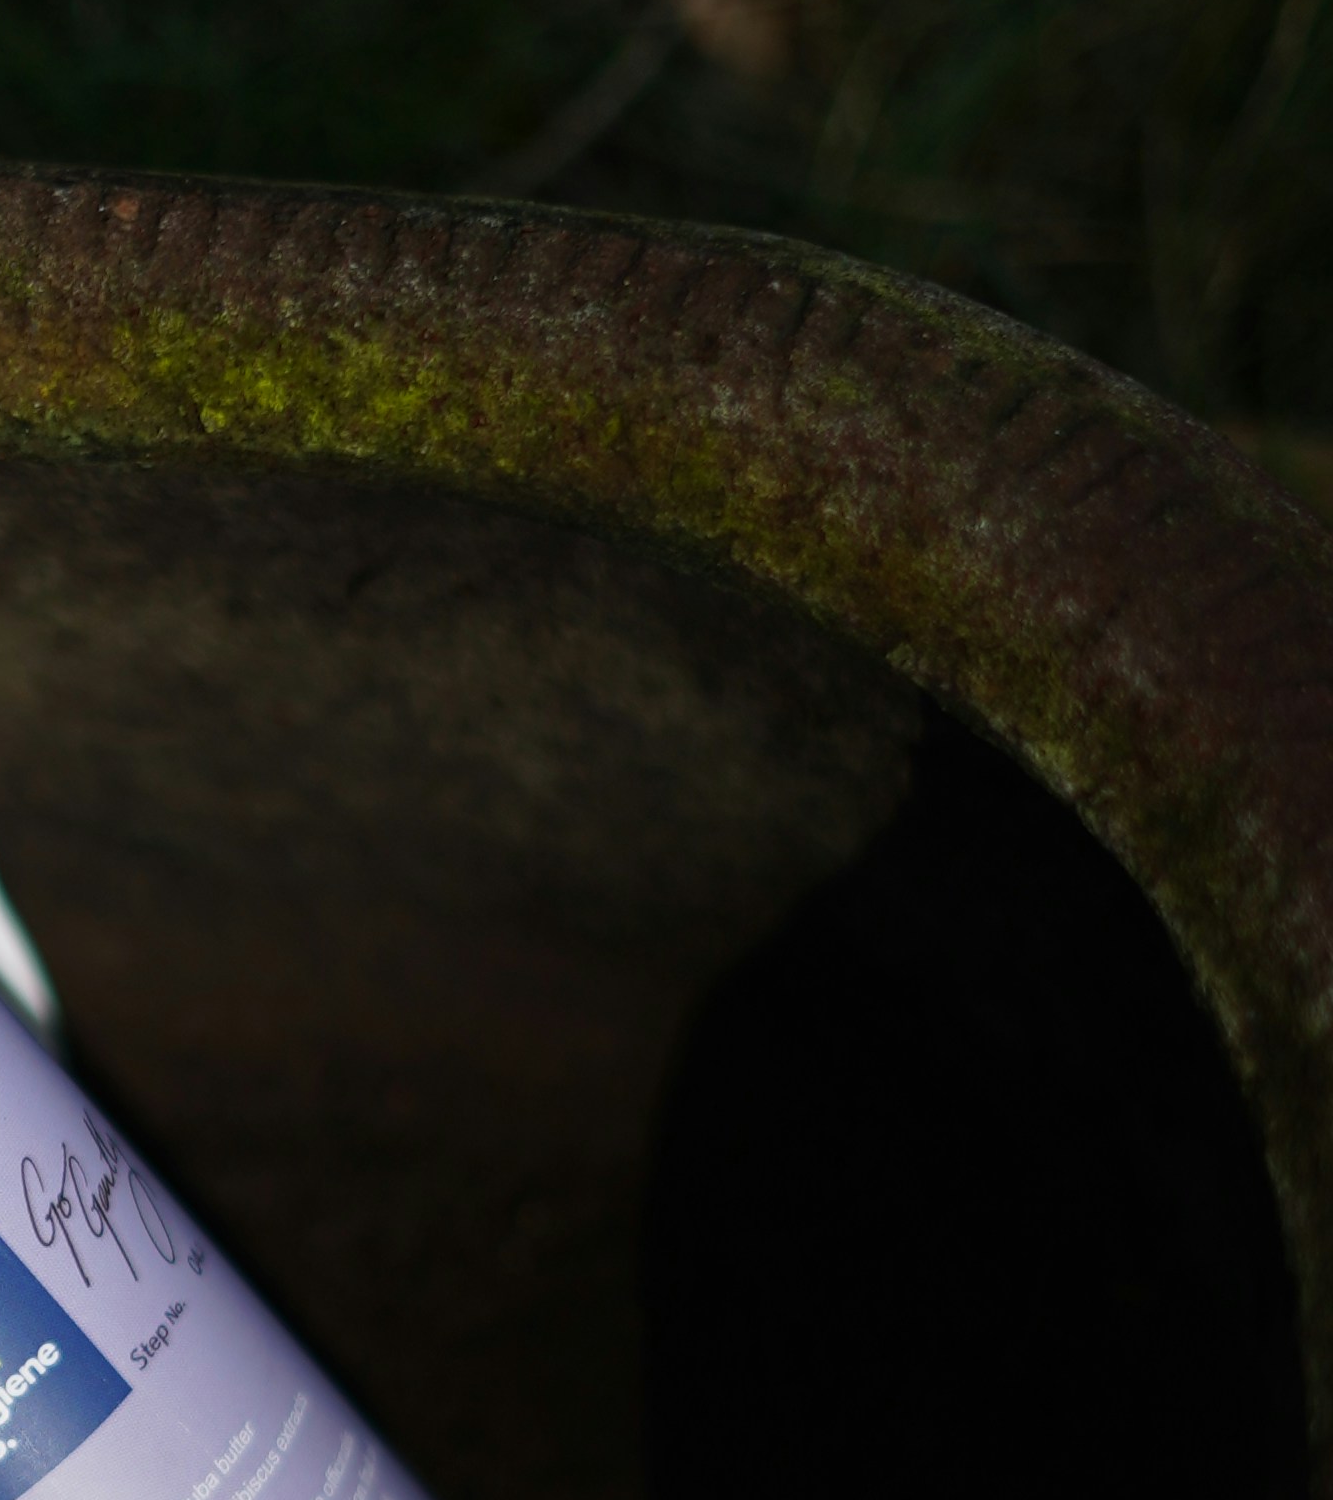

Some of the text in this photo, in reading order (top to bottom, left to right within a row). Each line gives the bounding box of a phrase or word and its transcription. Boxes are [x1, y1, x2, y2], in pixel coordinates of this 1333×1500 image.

[130, 1324, 169, 1370] Step
[164, 1301, 187, 1326] No.
[214, 1420, 255, 1474] butter
